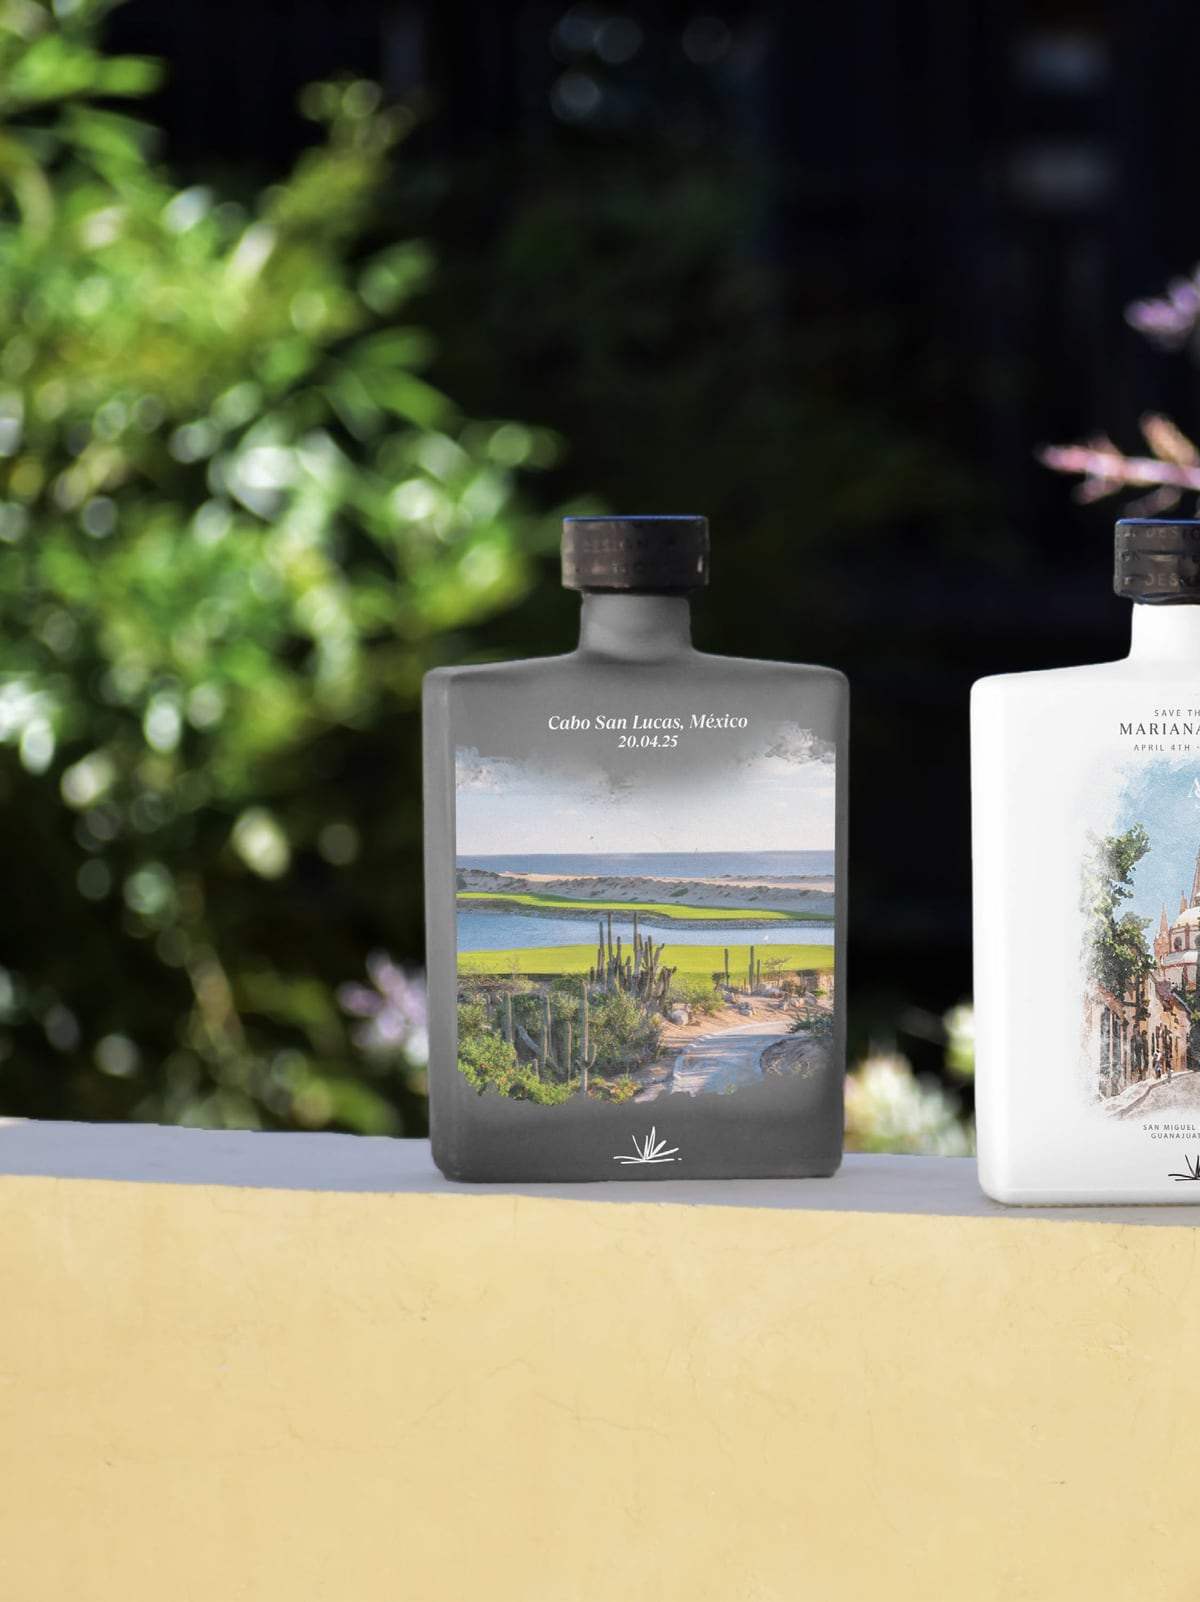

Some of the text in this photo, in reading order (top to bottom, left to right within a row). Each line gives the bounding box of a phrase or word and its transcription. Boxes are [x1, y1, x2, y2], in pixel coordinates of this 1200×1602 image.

[1153, 708, 1182, 717] SAVE
[548, 713, 748, 731] Cabo San Lucas, México
[617, 734, 679, 749] 20.04.25
[1133, 743, 1165, 752] APRIL
[1170, 743, 1191, 752] 4TH
